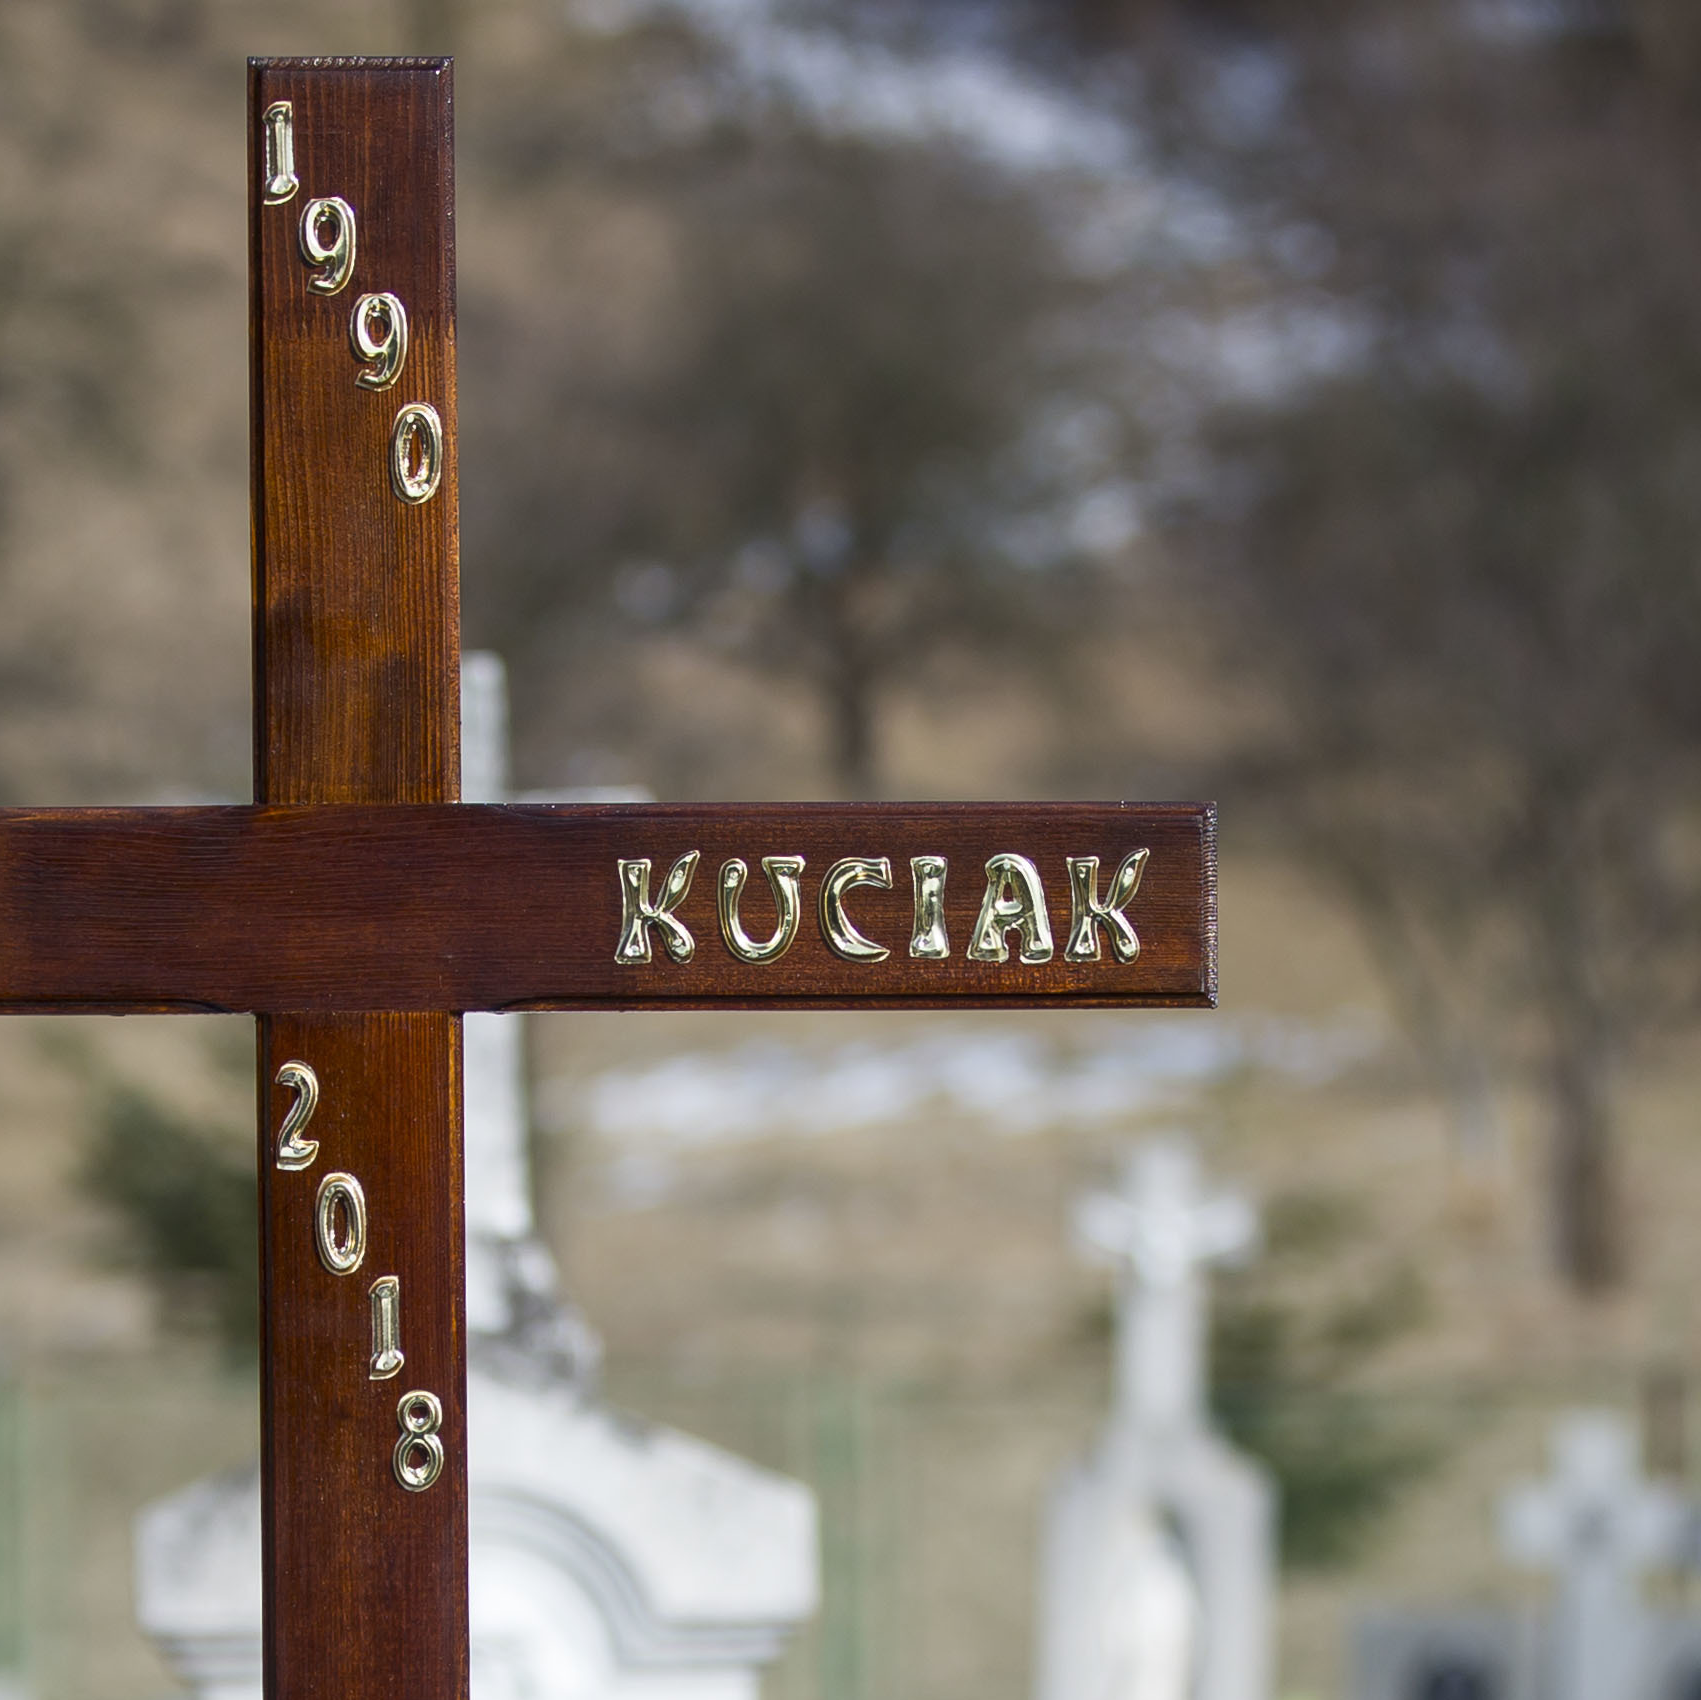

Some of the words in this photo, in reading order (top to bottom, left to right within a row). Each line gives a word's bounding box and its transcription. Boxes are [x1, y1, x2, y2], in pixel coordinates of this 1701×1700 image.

[262, 100, 443, 504] 1990
[614, 848, 1151, 965] KUCIAK
[275, 1060, 444, 1492] 2018
